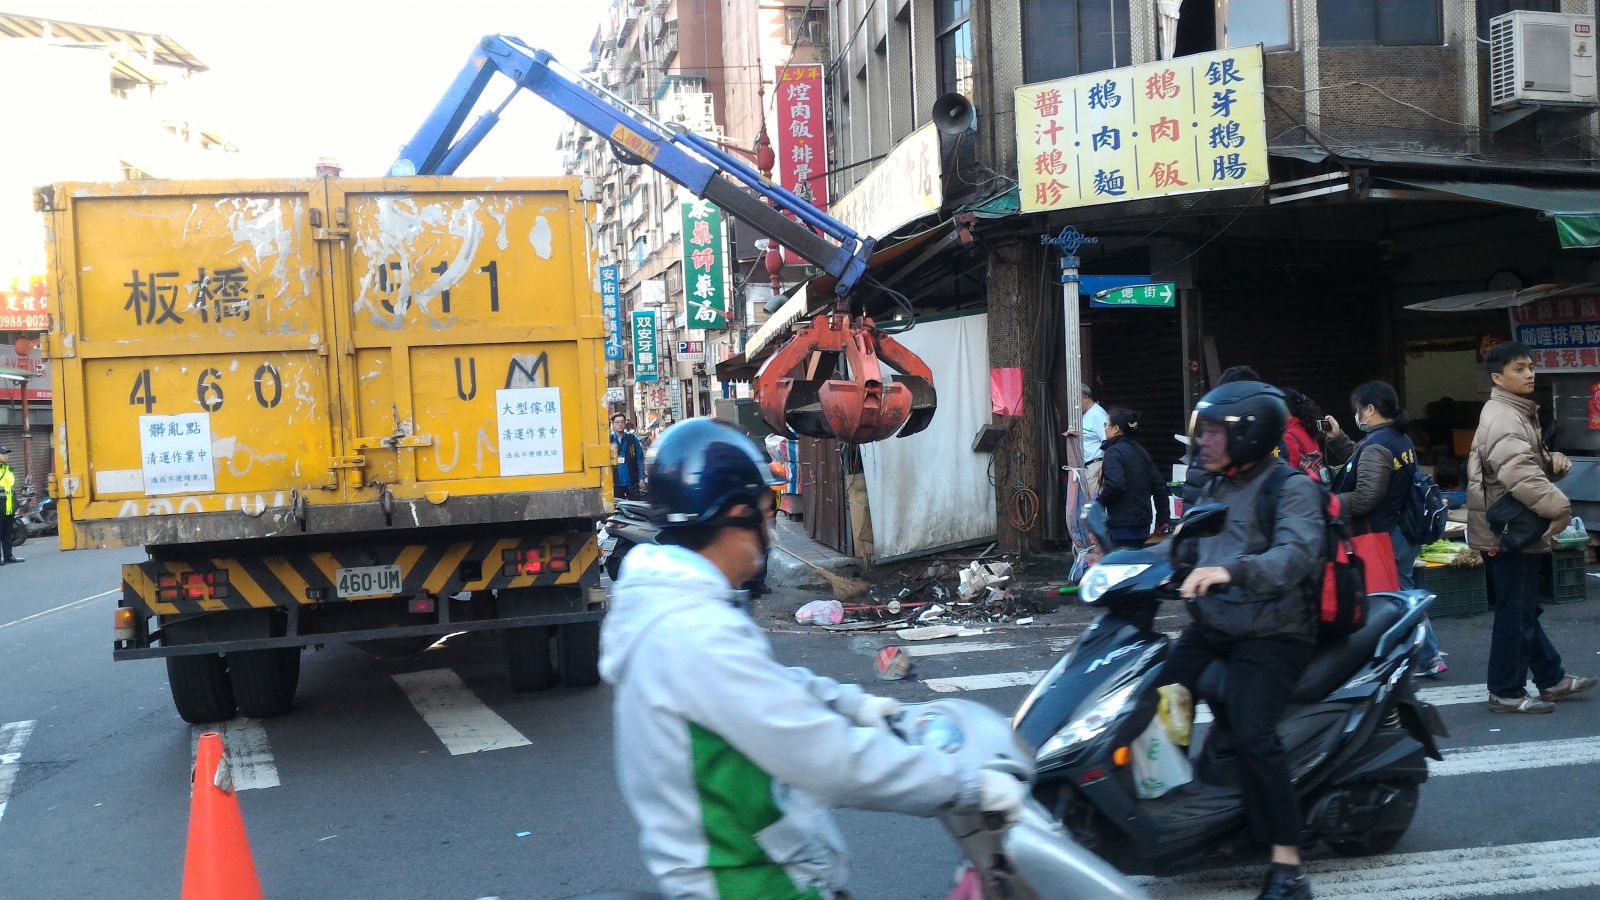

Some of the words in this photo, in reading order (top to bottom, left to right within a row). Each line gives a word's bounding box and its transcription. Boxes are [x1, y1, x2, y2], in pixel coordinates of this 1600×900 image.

[1145, 68, 1188, 189] 鵝肉飯
[1204, 57, 1248, 181] 銀芽鵝腸
[1033, 88, 1070, 207] 醬汁鵝胗
[1087, 79, 1128, 197] 鵝肉麵
[502, 400, 557, 416] 大型傢俱
[149, 421, 201, 438] 髒亂點
[502, 425, 558, 441] 清運作業中
[147, 449, 207, 465] 清運作業中
[339, 570, 400, 593] 460-UM
